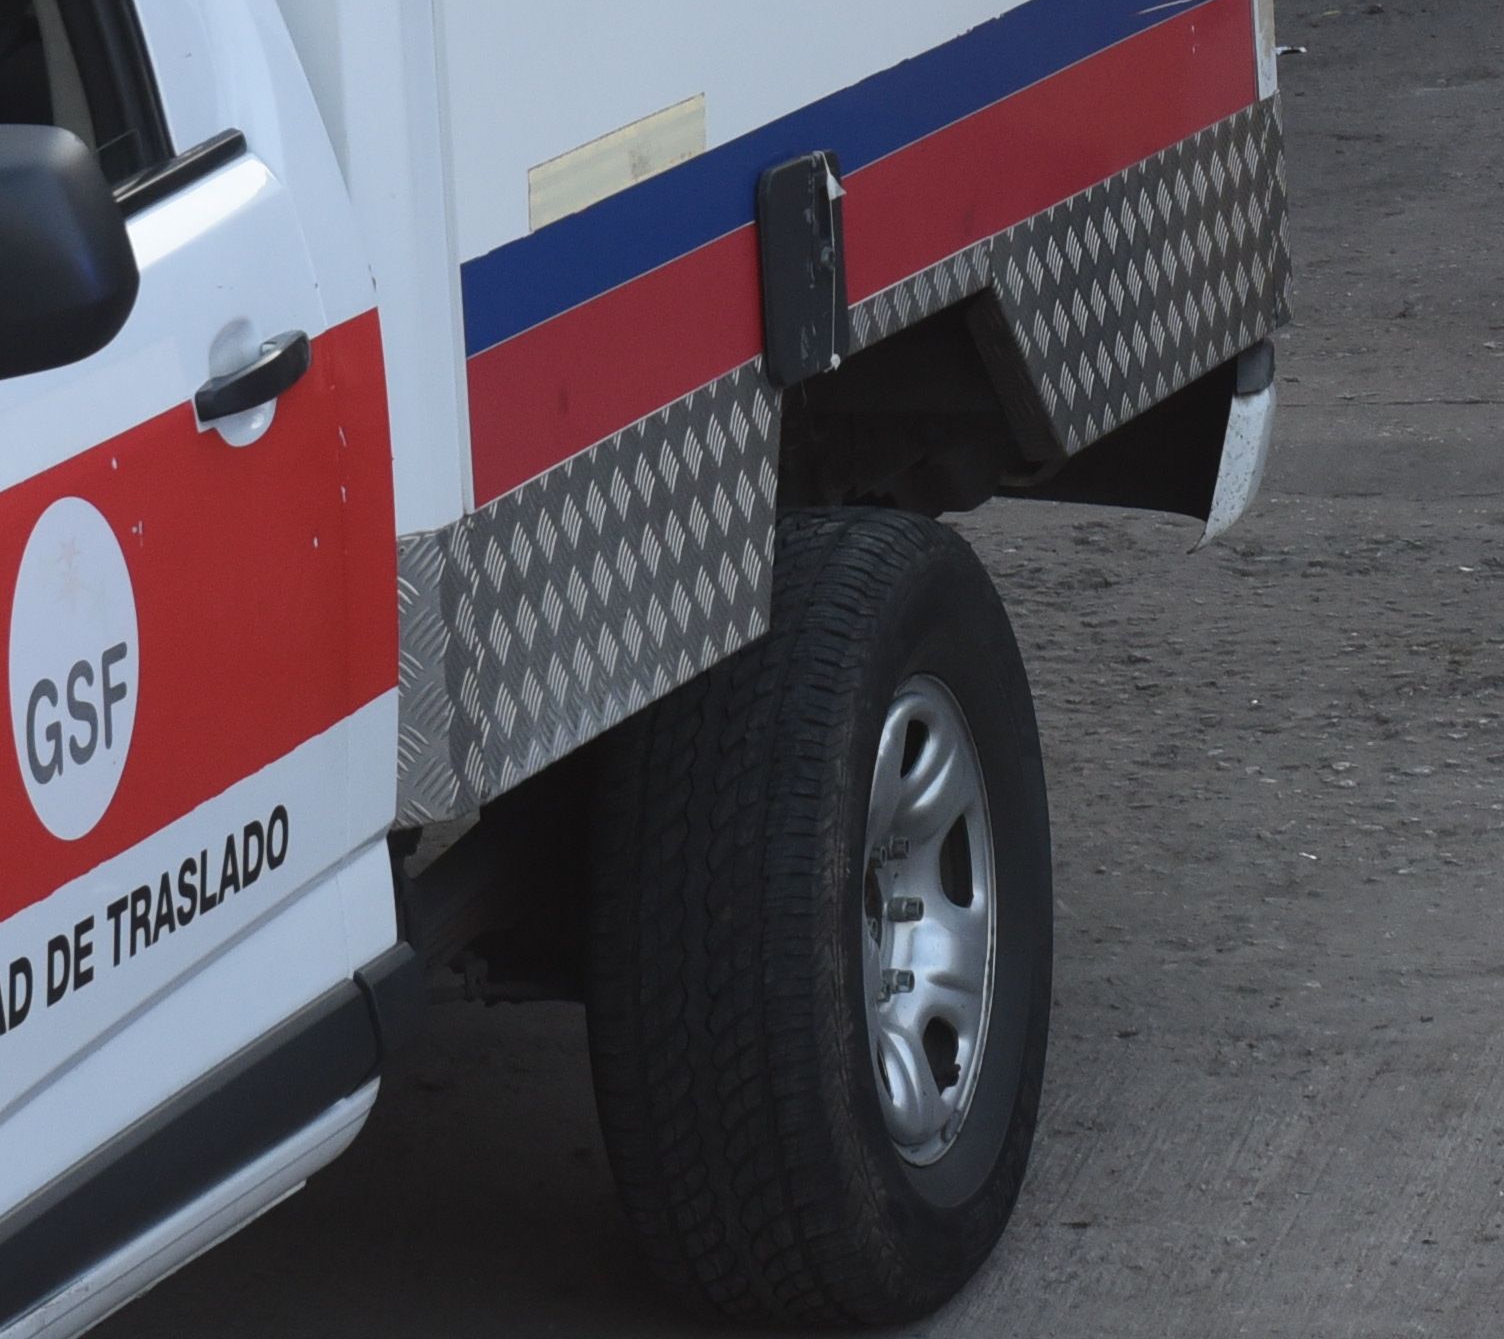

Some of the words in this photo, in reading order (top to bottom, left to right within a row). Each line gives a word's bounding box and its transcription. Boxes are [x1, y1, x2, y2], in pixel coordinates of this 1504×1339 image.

[26, 641, 128, 784] GSF
[47, 914, 95, 1008] DE
[107, 804, 289, 968] TRASLADO
